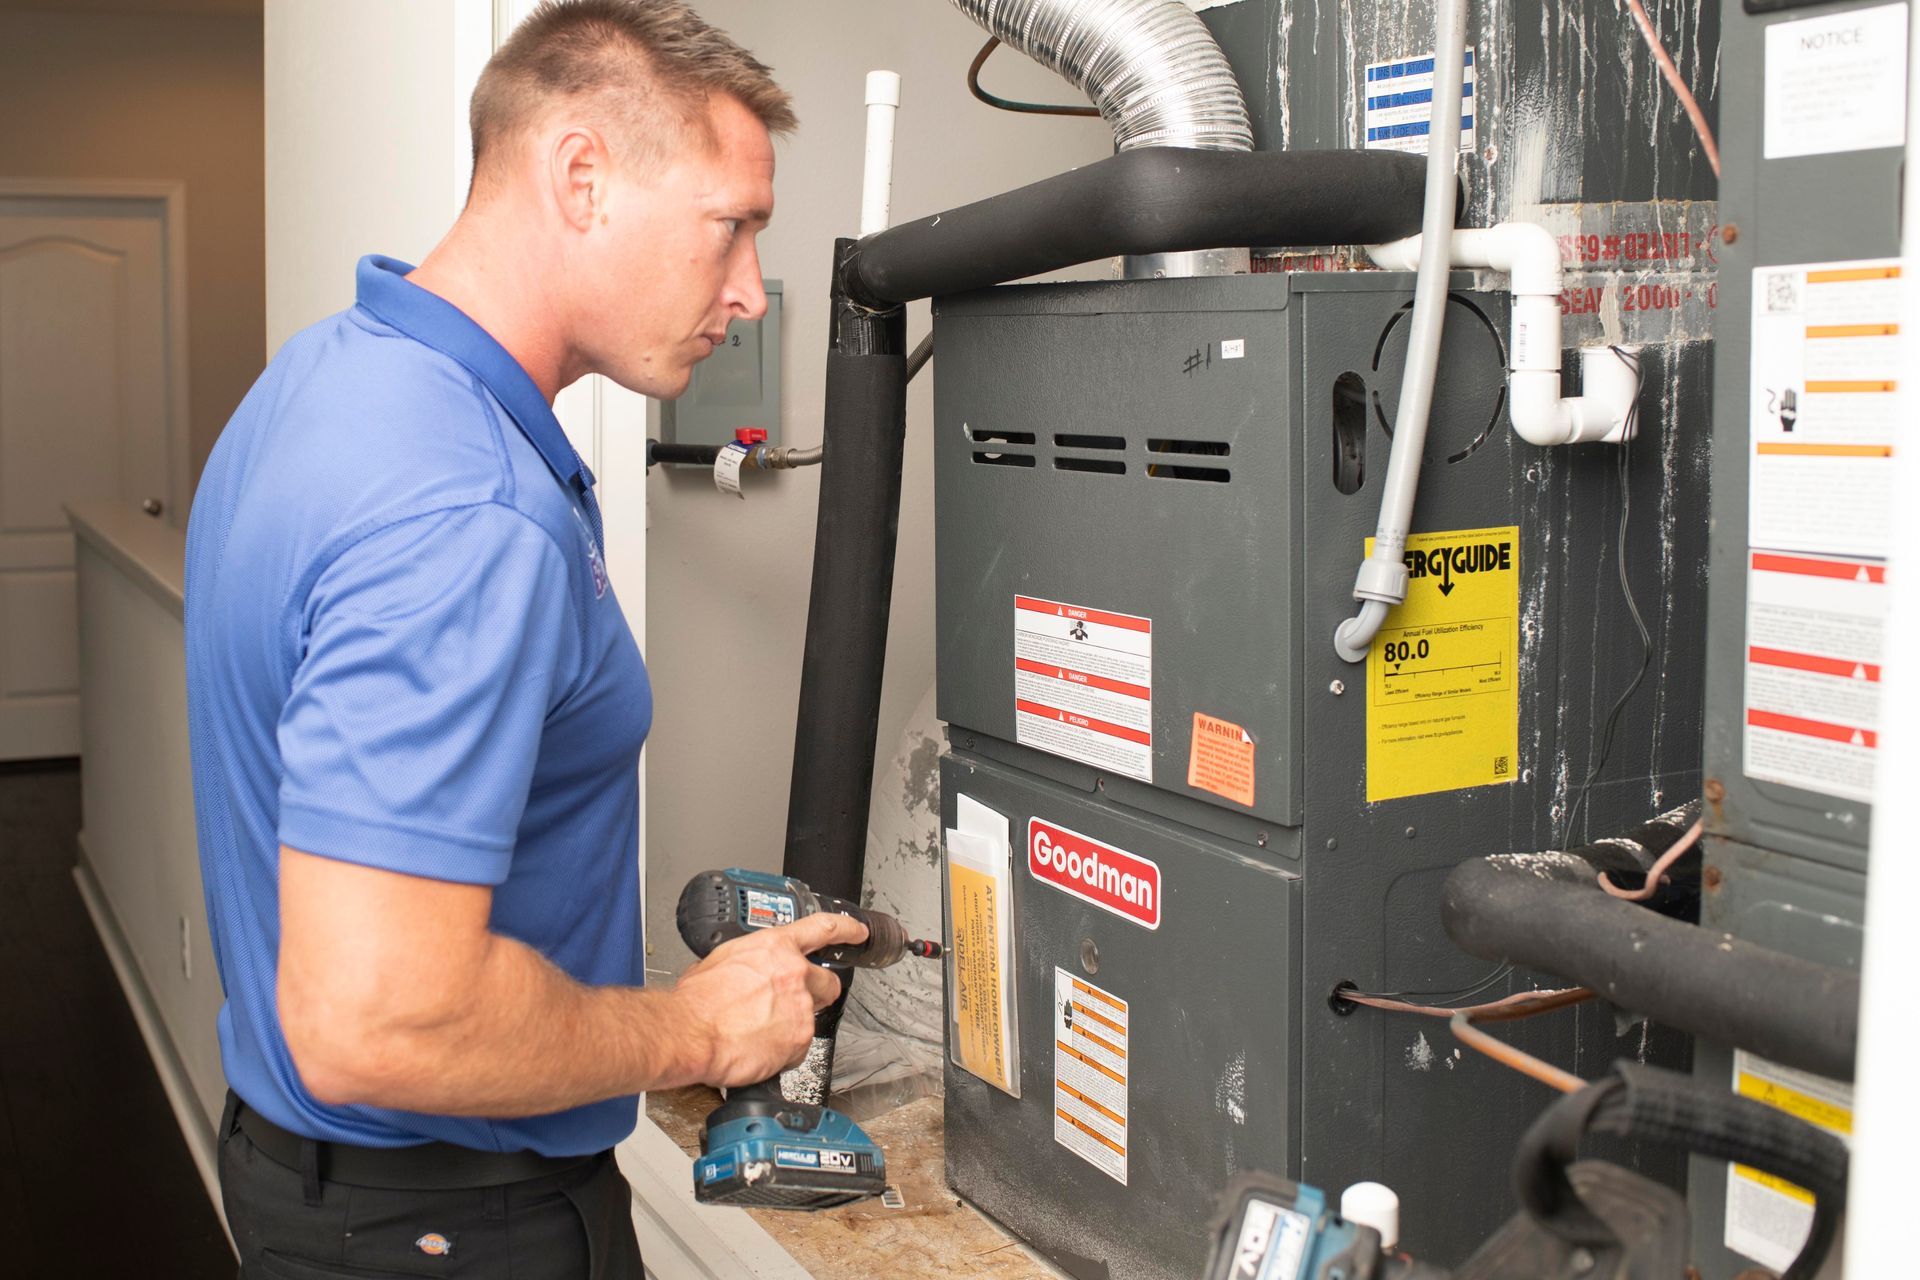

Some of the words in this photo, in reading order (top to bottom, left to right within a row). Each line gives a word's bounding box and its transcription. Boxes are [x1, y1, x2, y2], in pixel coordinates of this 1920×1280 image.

[1801, 27, 1864, 50] NOTICE
[1624, 232, 1690, 260] LISTED
[1623, 283, 1681, 312] 2000
[731, 334, 742, 347] 2
[1182, 343, 1212, 379] #1
[1403, 542, 1511, 579] ERGYGUIDE
[1068, 608, 1087, 619] DANGER
[1403, 628, 1421, 638] Annual
[1422, 628, 1433, 636] Fuel
[1434, 626, 1459, 635] Utilization
[1460, 623, 1484, 632] Efficiency
[1384, 639, 1429, 662] 80.0
[1068, 672, 1088, 683] DANGER
[1069, 715, 1089, 726] PELIGRO
[1198, 718, 1243, 742] WARNIN
[1033, 831, 1153, 910] Goodman
[986, 885, 995, 973] ATTENTION
[820, 1150, 851, 1166] 20V
